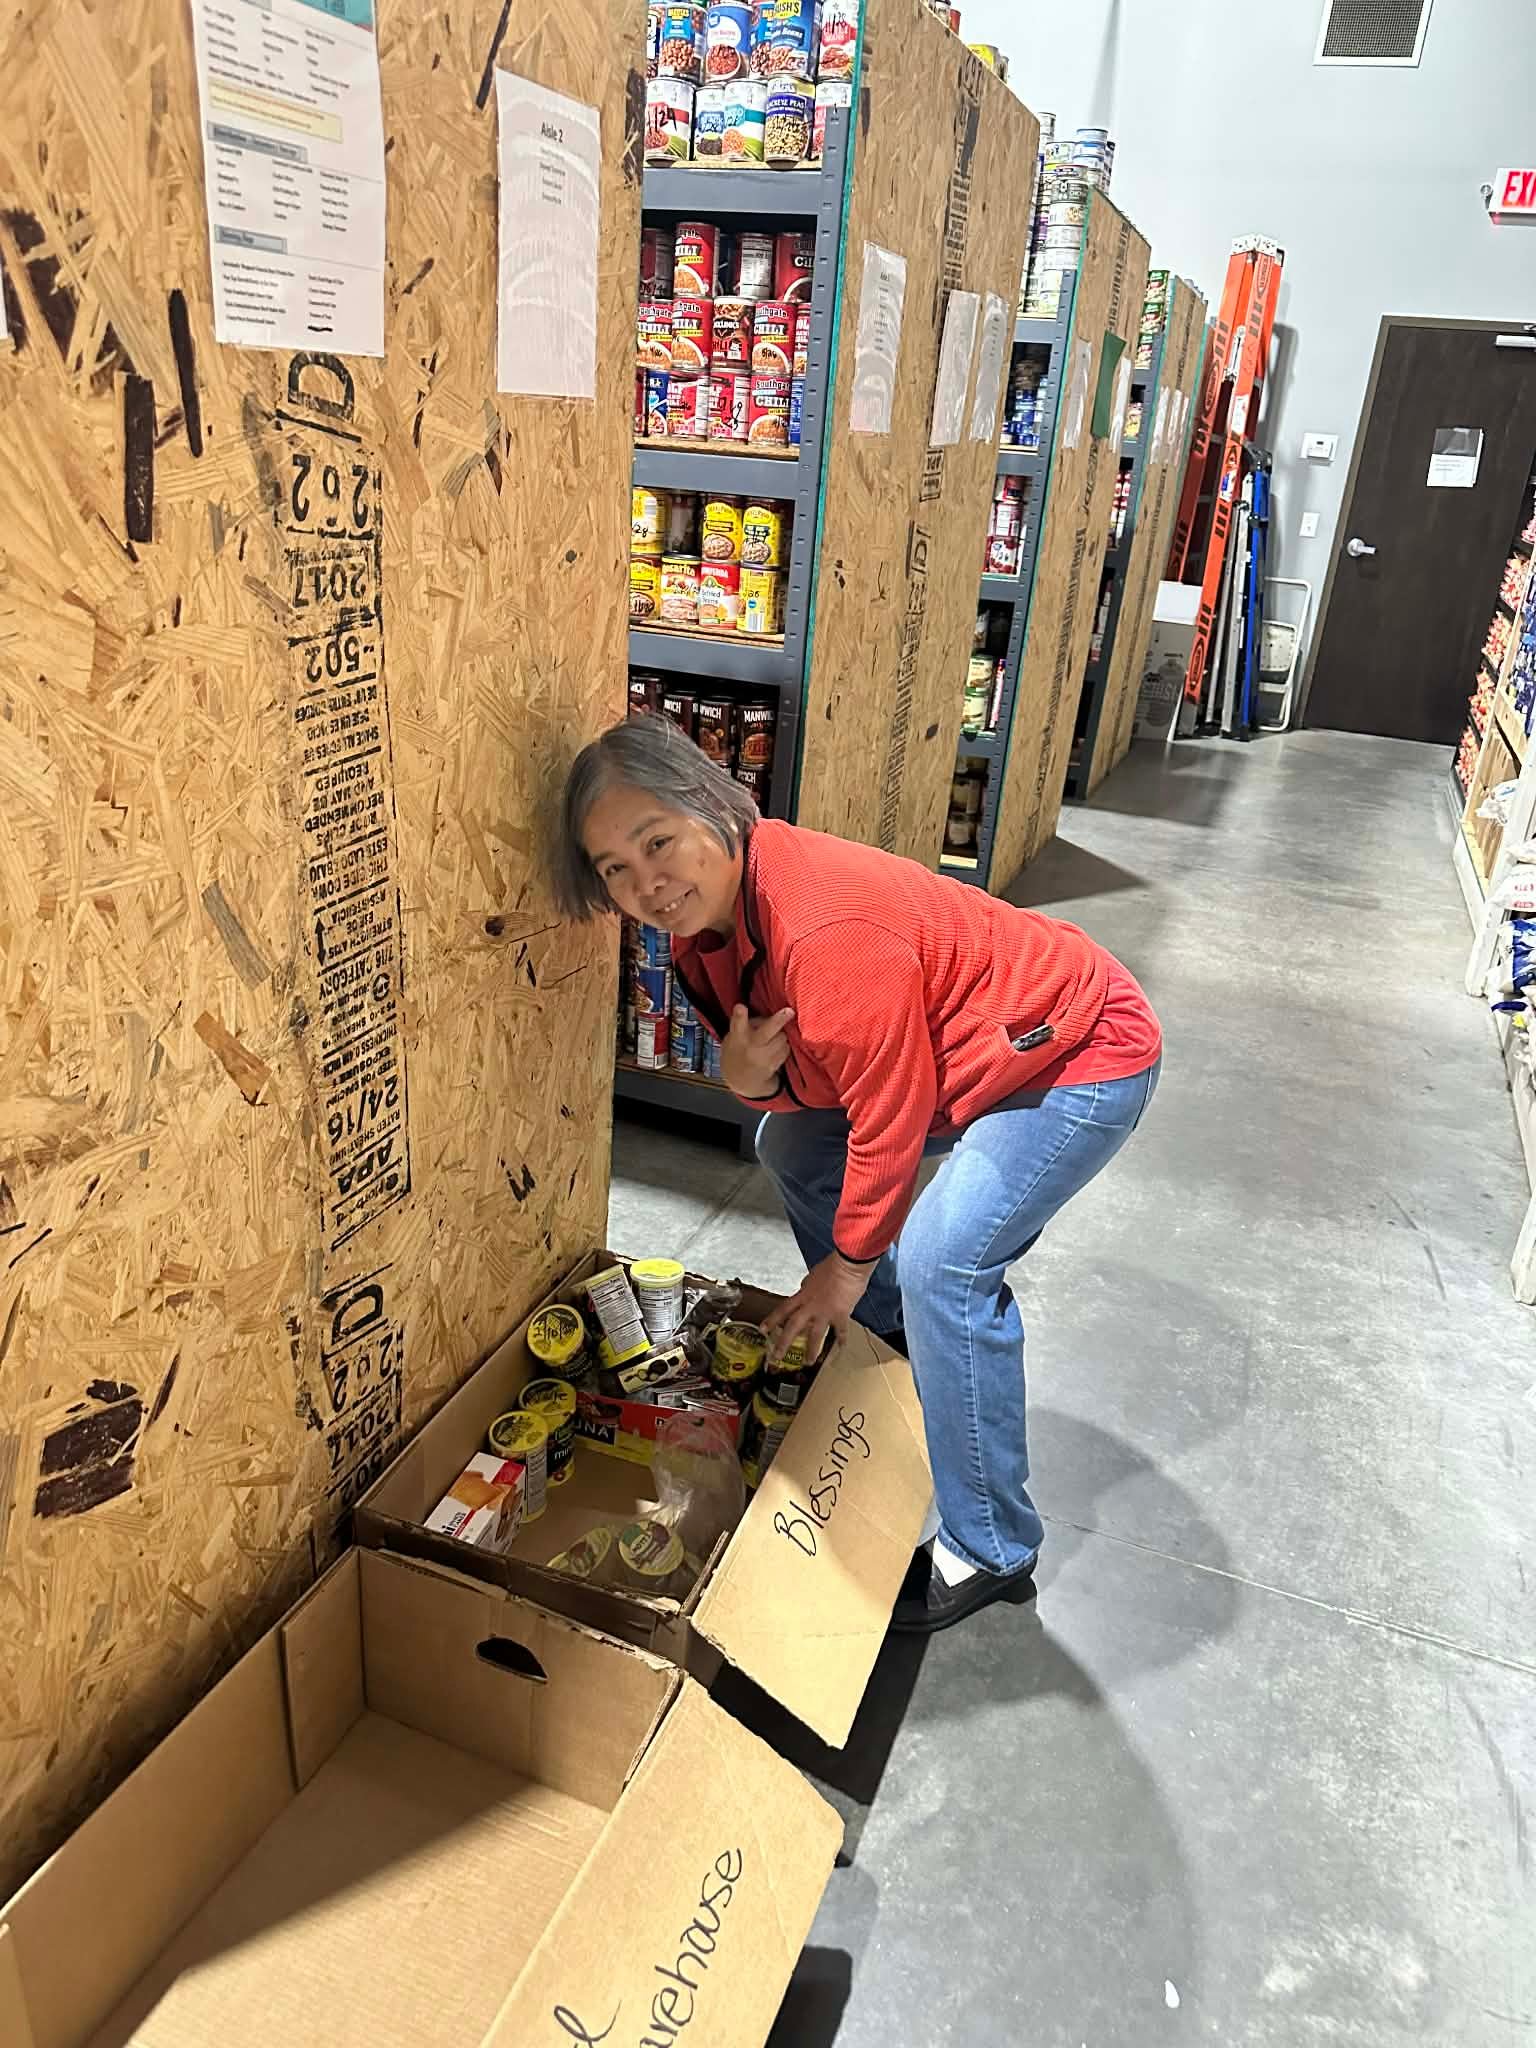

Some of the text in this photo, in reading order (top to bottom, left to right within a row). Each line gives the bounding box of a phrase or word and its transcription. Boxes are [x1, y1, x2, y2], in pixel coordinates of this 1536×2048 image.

[541, 122, 564, 143] Aisle 2
[292, 563, 367, 608] 2017
[315, 761, 369, 791] REQUIRED
[304, 790, 385, 833] RECOMMENDED
[331, 785, 351, 806] MAY
[311, 878, 341, 899] DOWN
[319, 944, 394, 1000] 7/16 CATEGORY
[360, 1024, 397, 1053] THICKNESS
[337, 1046, 391, 1083] EXPOSURE
[327, 1075, 399, 1147] 24/16
[376, 1109, 401, 1132] RATED
[337, 1138, 394, 1196] APA
[774, 1406, 871, 1557] Blessings
